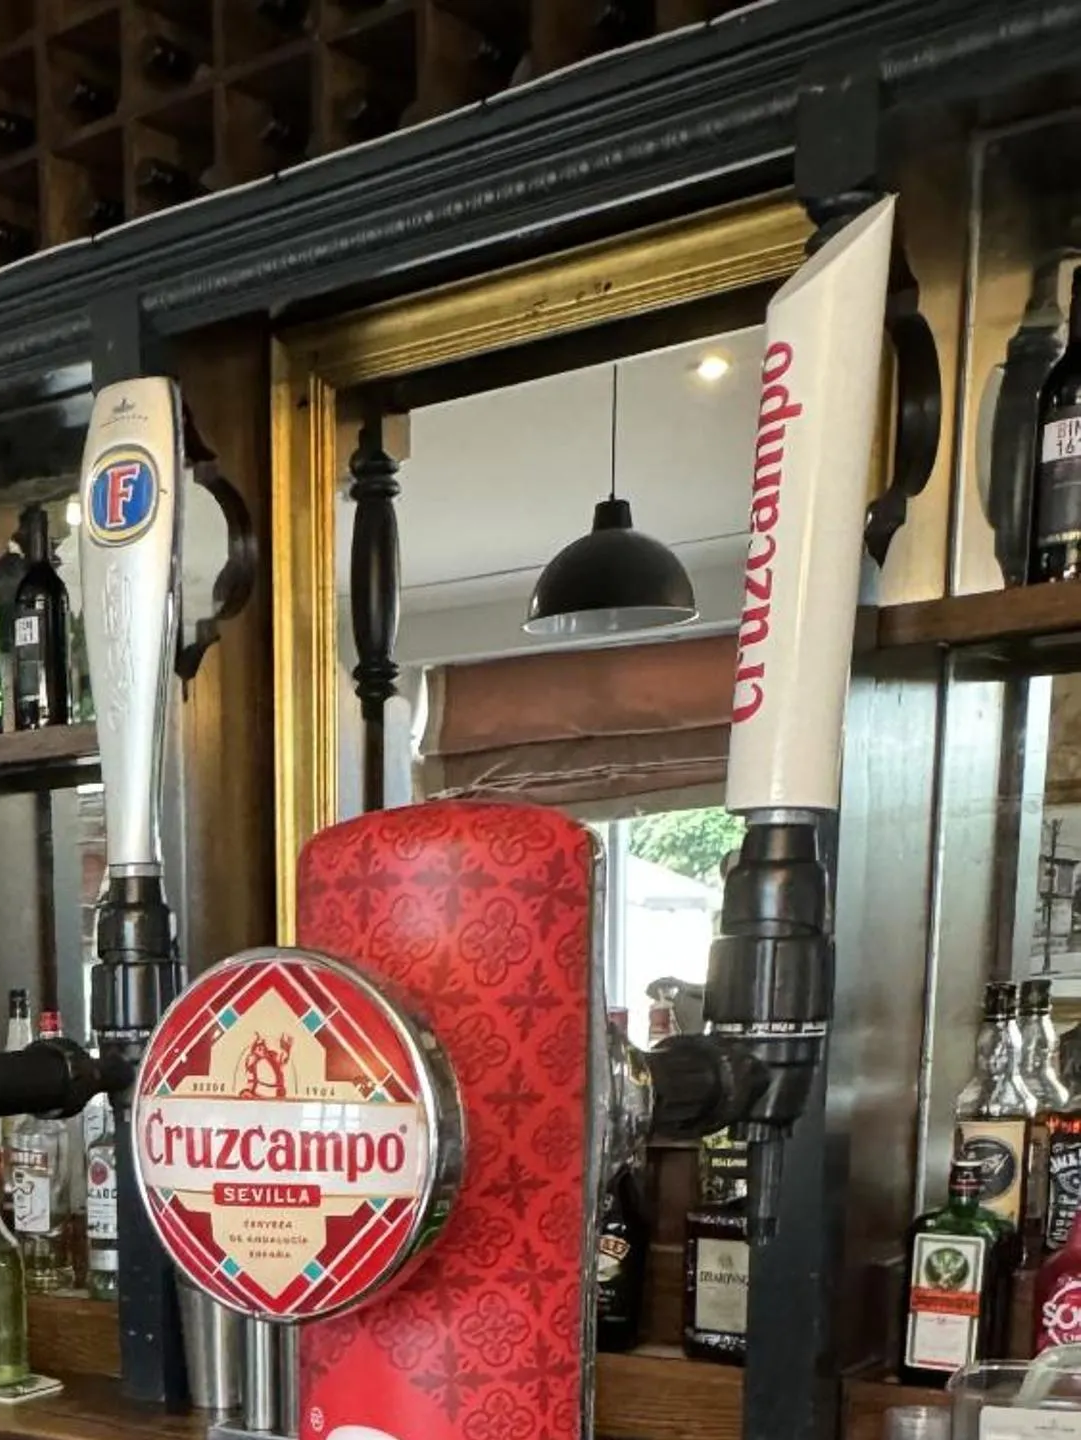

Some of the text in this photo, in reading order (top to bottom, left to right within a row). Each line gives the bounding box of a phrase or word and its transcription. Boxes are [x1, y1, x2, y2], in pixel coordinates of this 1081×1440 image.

[105, 463, 140, 528] F
[144, 1109, 406, 1183] Cruzcampo
[223, 1186, 310, 1204] SEVILLA
